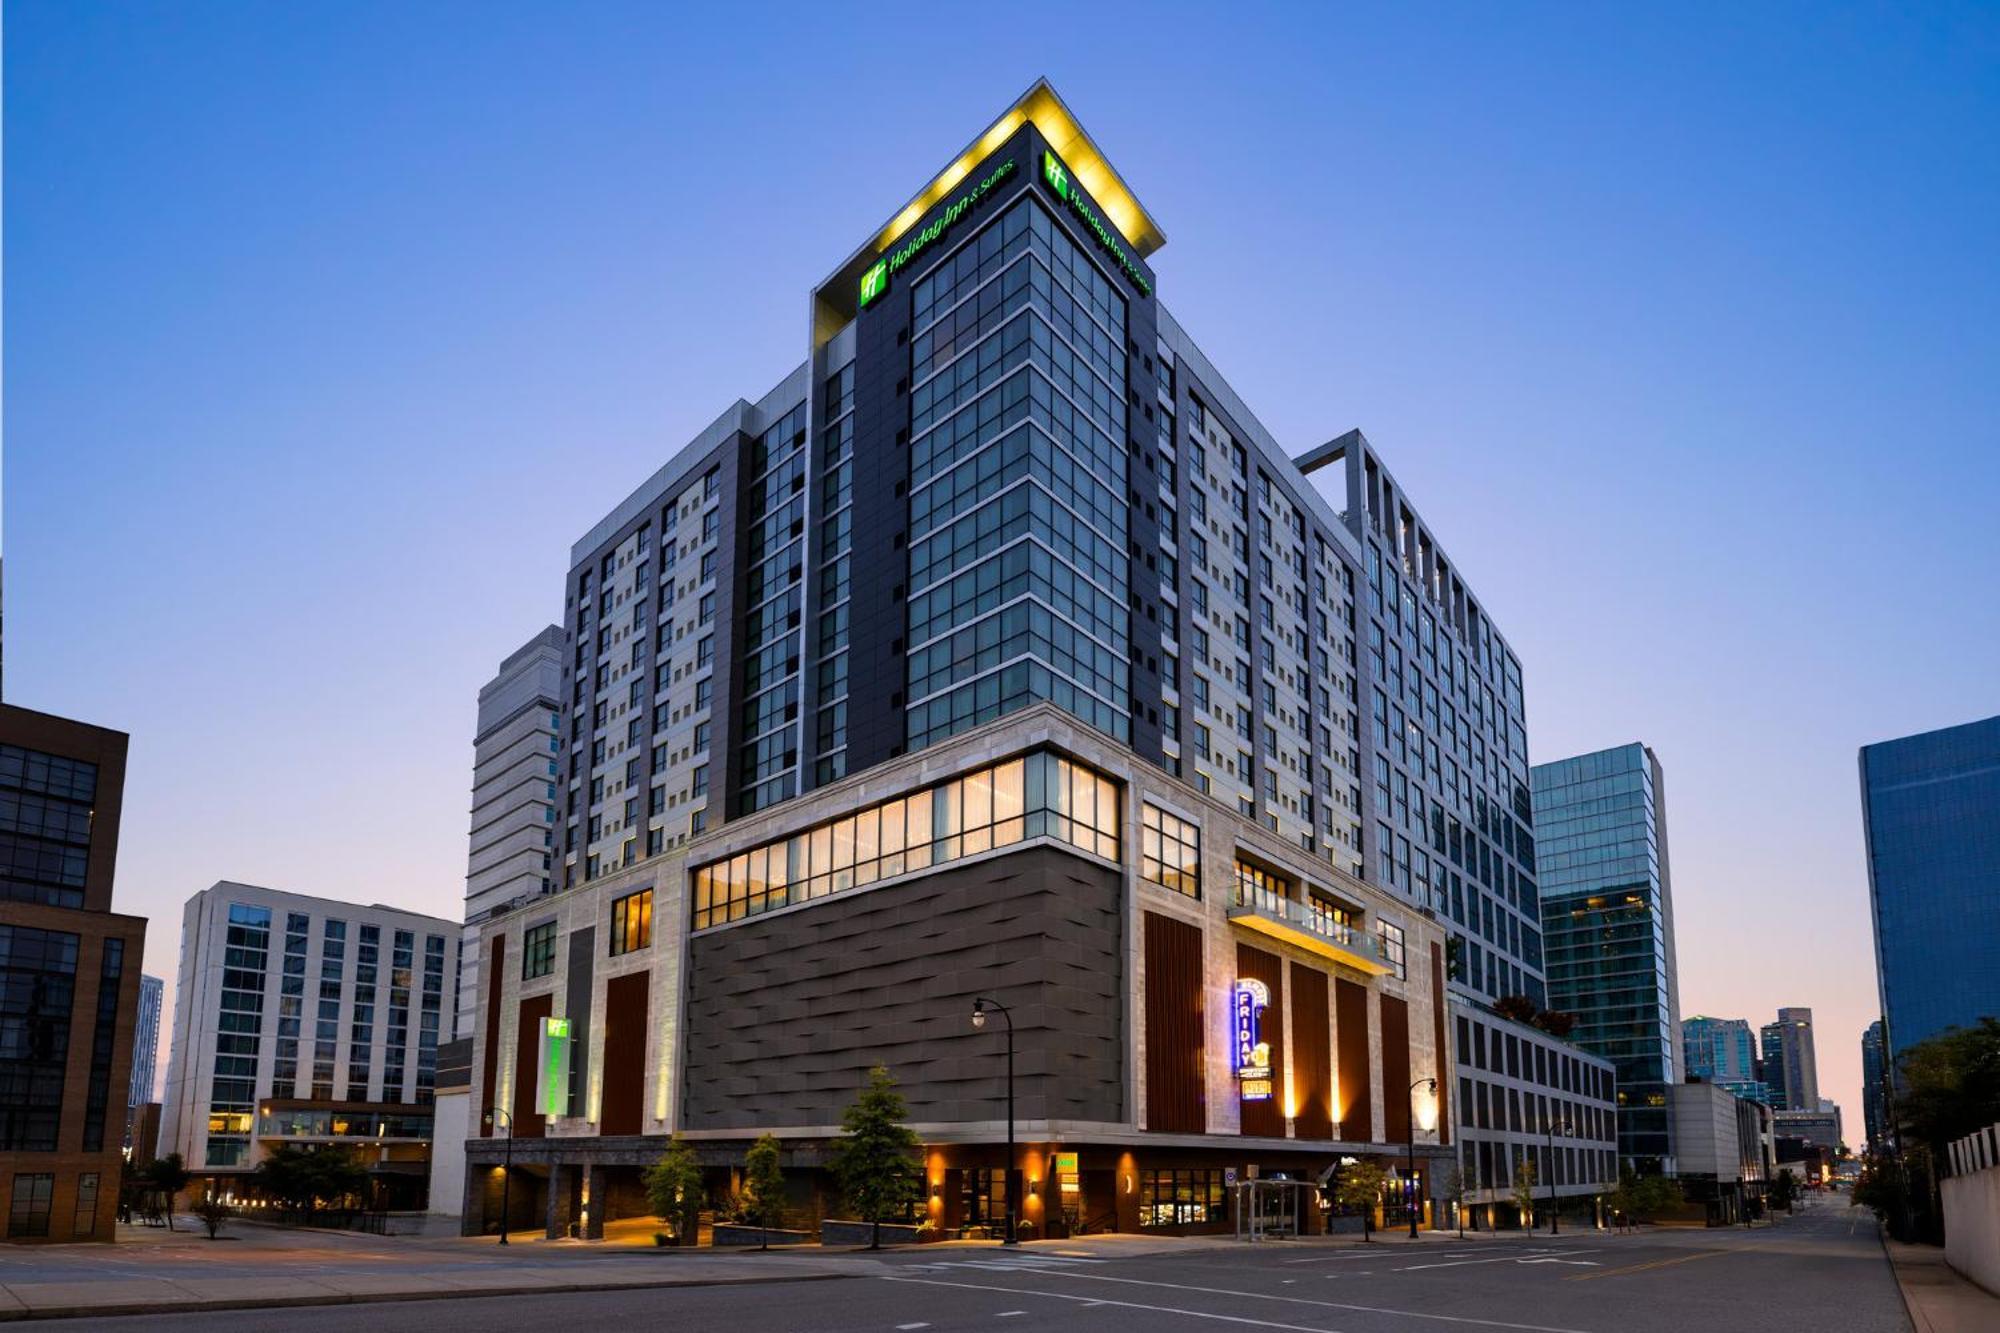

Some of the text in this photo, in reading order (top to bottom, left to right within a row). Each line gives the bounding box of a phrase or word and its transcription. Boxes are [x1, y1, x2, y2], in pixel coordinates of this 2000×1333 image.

[890, 158, 1014, 271] Holiday Inn & Suites
[1070, 188, 1111, 245] Holiday
[1110, 236, 1127, 264] Inn
[1239, 993, 1251, 1066] FRIDAY
